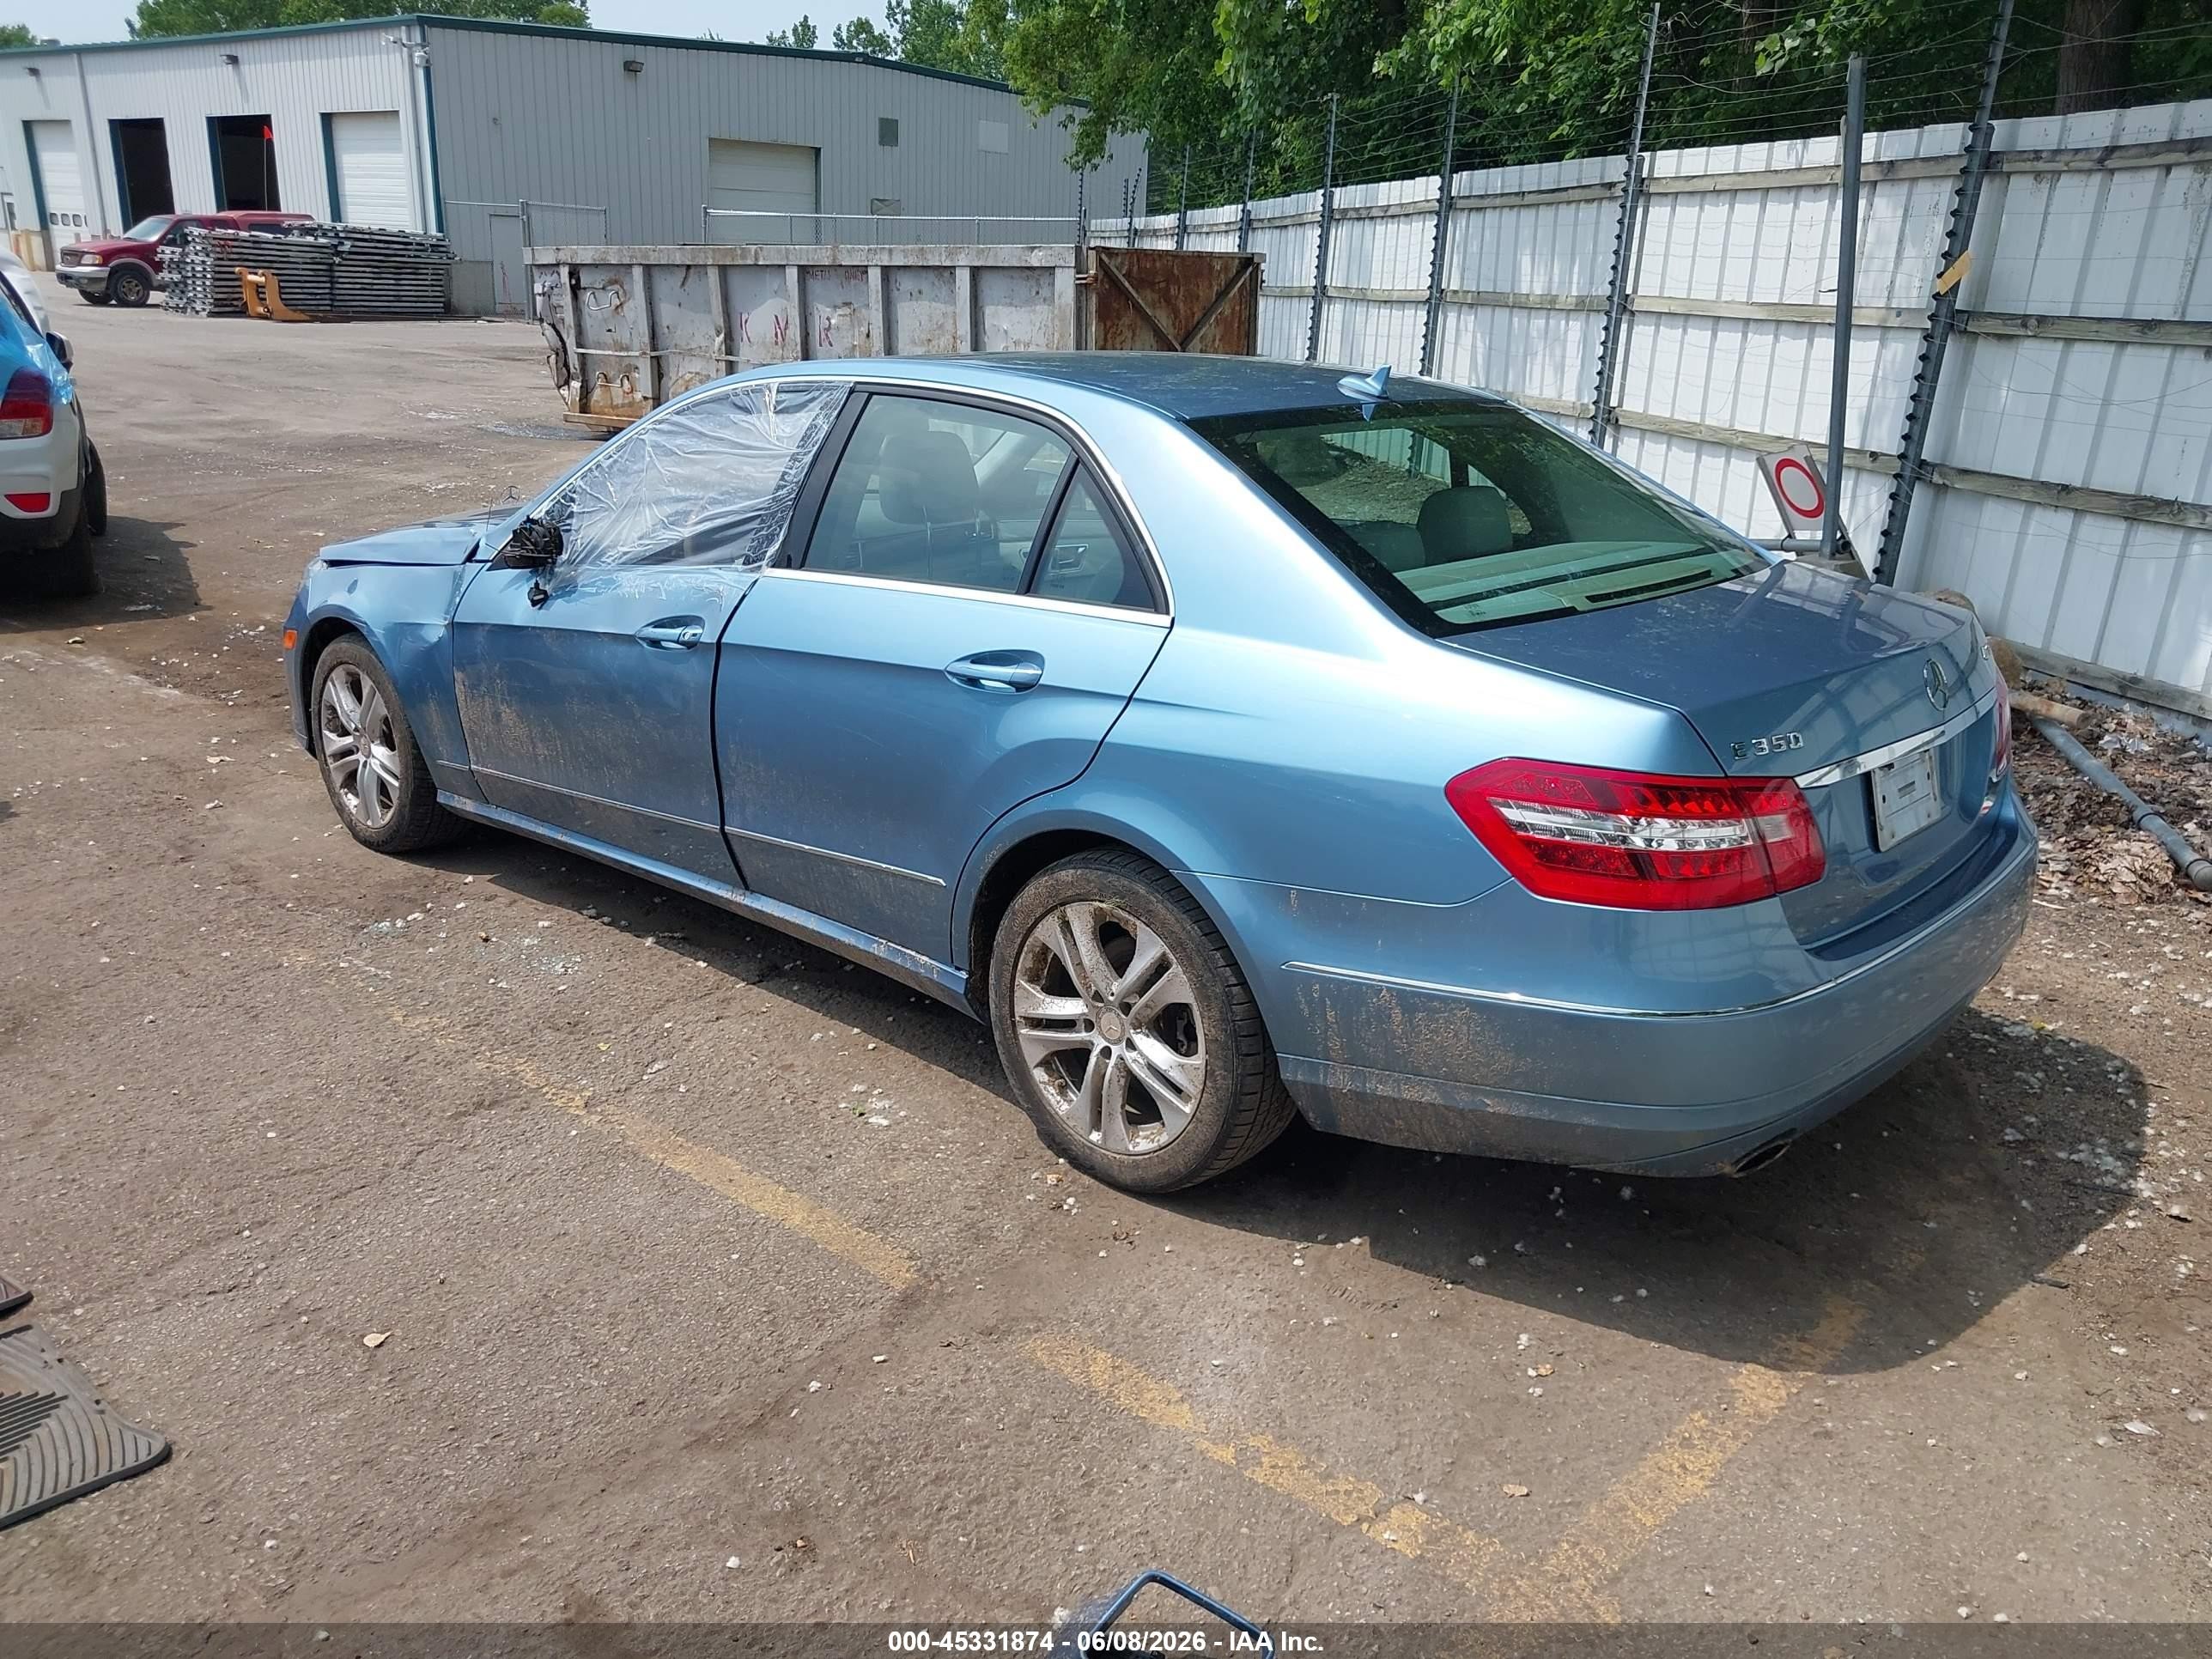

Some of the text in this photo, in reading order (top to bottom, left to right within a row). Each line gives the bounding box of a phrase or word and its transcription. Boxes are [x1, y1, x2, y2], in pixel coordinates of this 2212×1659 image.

[817, 314, 834, 348] R
[1730, 732, 1804, 760] E 350
